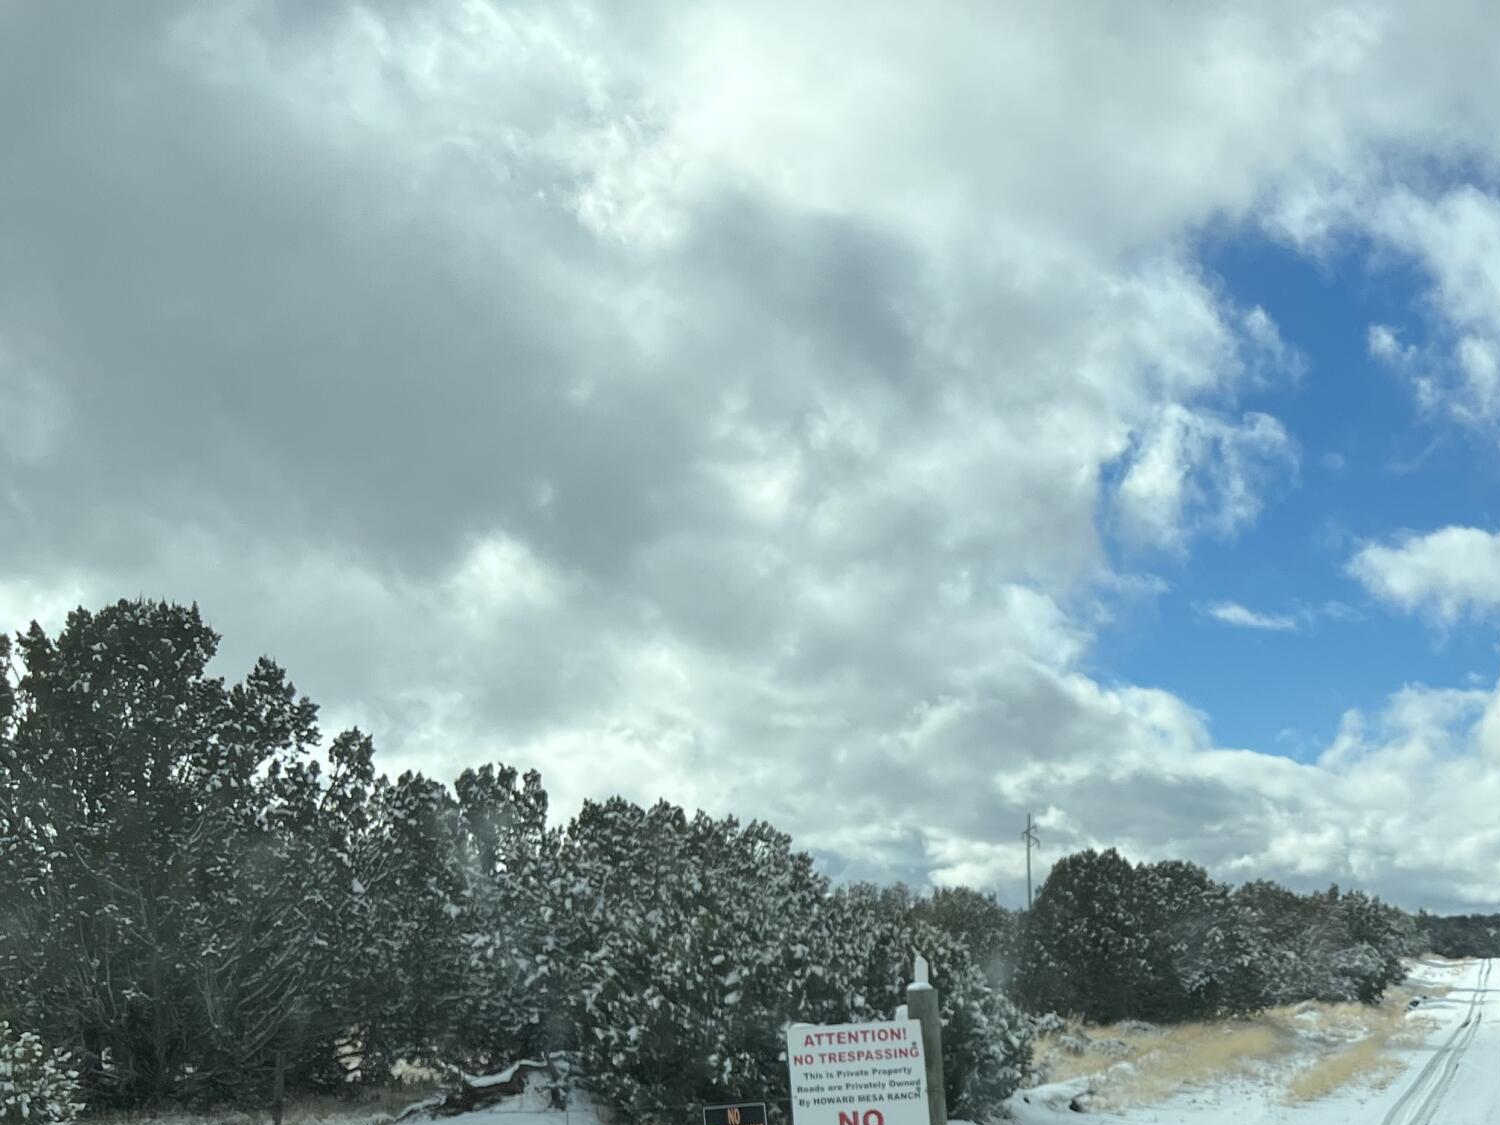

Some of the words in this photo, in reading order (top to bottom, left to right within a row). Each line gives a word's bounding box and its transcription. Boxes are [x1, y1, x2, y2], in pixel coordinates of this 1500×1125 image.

[804, 1027, 907, 1047] ATTENTION!
[794, 1055, 814, 1066] NO
[819, 1047, 919, 1064] TRESPASSING
[837, 1069, 869, 1078] Private
[872, 1067, 912, 1076] Property
[797, 1085, 824, 1093] Roads
[846, 1081, 886, 1091] Privately
[889, 1078, 921, 1086] Owned
[799, 1099, 811, 1108] By
[814, 1097, 855, 1105] HOWARD
[858, 1095, 884, 1103] MESA
[888, 1092, 921, 1100] RANCH
[728, 1108, 740, 1125] NO
